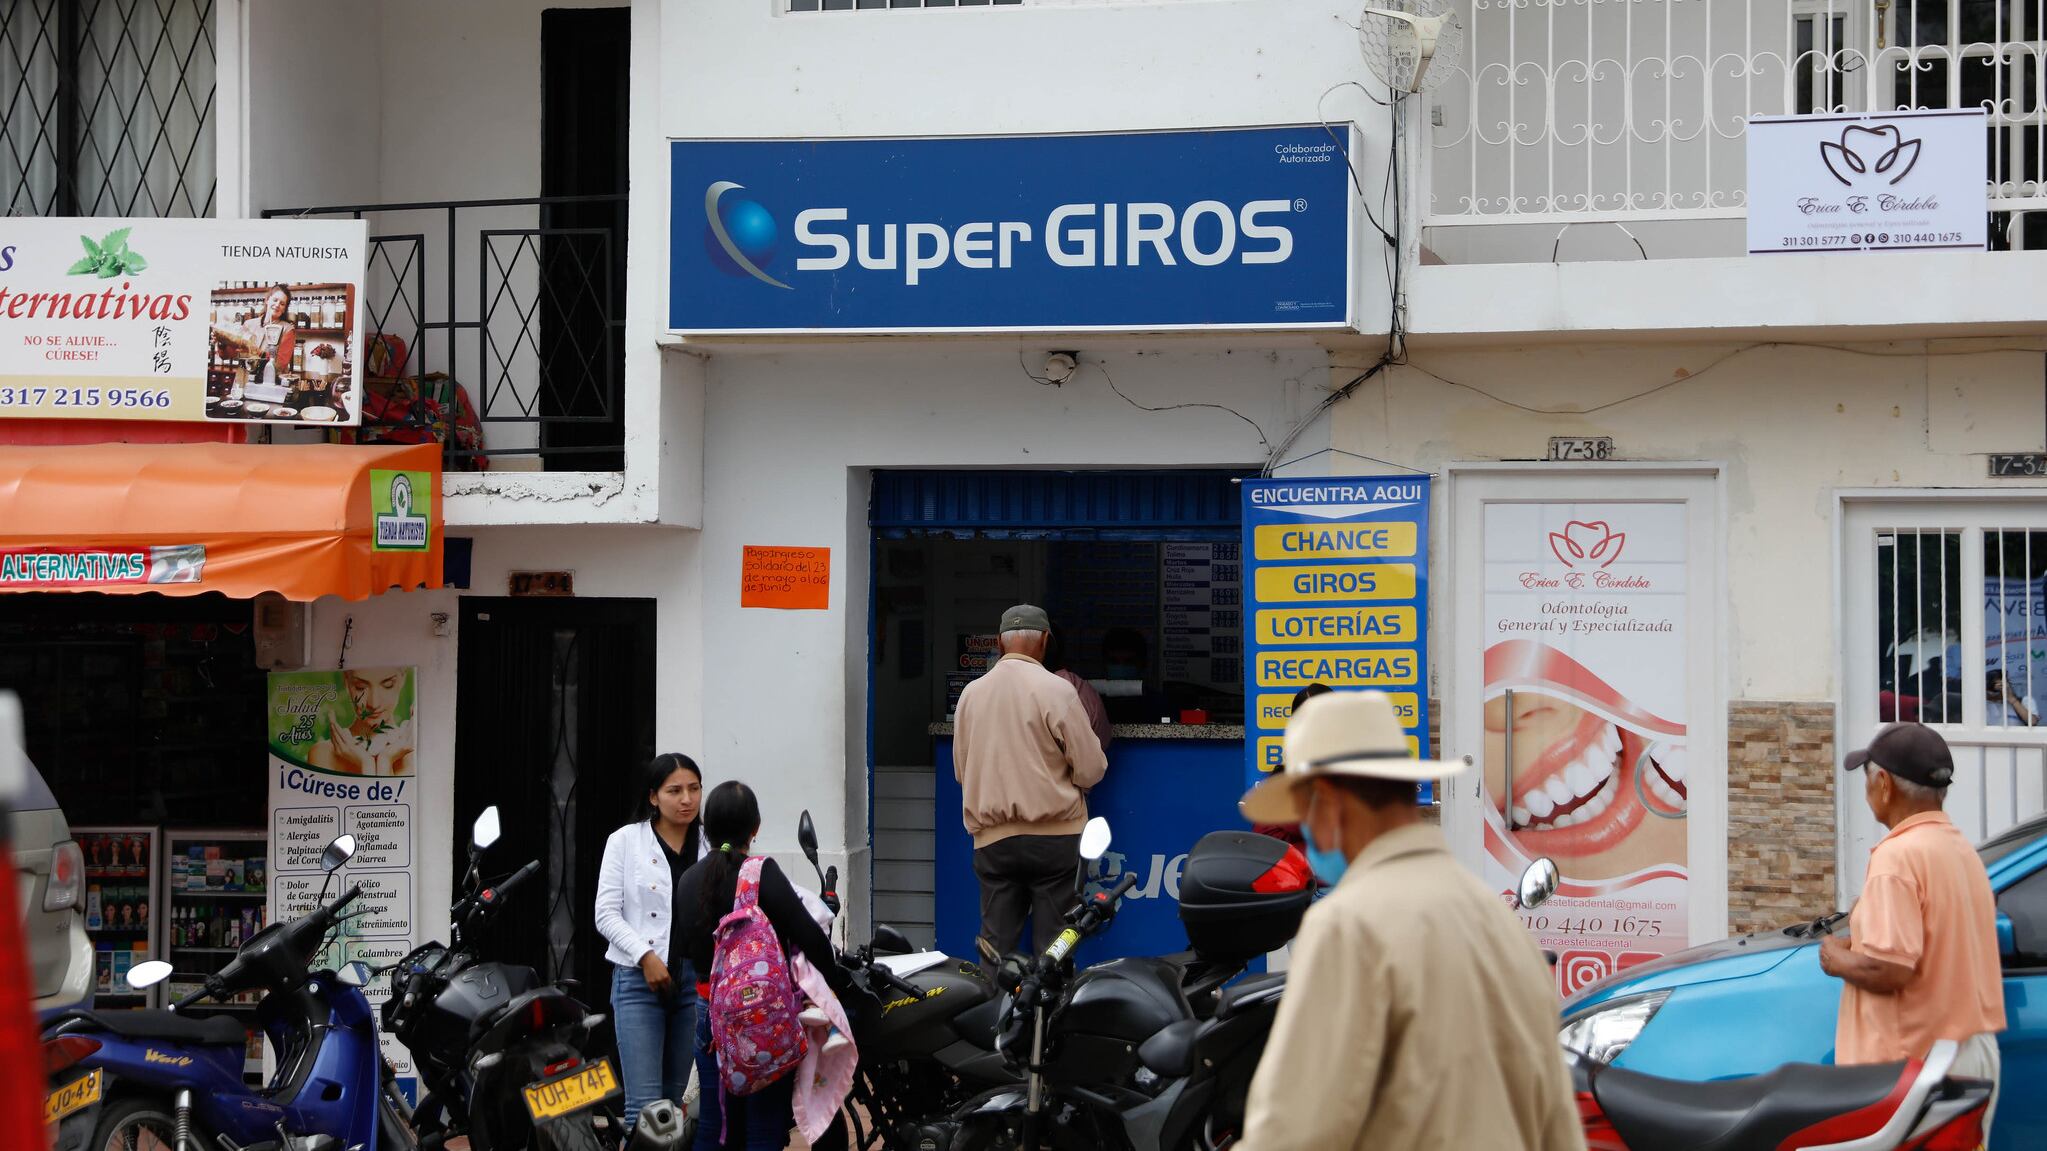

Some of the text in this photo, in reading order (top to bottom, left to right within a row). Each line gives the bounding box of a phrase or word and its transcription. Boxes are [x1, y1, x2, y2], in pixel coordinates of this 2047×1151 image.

[1275, 142, 1336, 154] Colaborador
[1280, 153, 1331, 163] Autorizado
[1797, 193, 1939, 215] Erica E. Córdoba
[1782, 232, 1962, 246] 311 301 5777 310 440 1675
[794, 207, 1032, 285] Super
[222, 245, 348, 260] TIENDA NATURISTA
[24, 336, 117, 347] NO SE ALIVIE...
[45, 348, 98, 360] CÚRESE!
[1, 389, 170, 407] 317 215 9566
[1552, 440, 1607, 460] 17-38
[1251, 485, 1421, 503] ENCUENTRA AQUI
[1282, 529, 1388, 551] CHANCE
[1, 553, 144, 581] ALTERNATIVAS
[1293, 572, 1376, 594] GIROS
[1518, 571, 1650, 589] Erica E. Córdoba
[1272, 611, 1401, 637] LOTERÍAS
[1498, 618, 1672, 635] General y Especializada
[1263, 657, 1411, 680] RECARGAS
[277, 692, 336, 714] Salud
[300, 715, 316, 728] 25
[279, 726, 313, 745] Años
[280, 765, 405, 802] ¡Cúrese de!
[286, 814, 334, 826] Amigdalitis
[356, 810, 397, 819] Cansancio,
[356, 820, 405, 830] Agotamiento
[287, 832, 320, 842] Alergias
[357, 833, 380, 842] Vejiga
[287, 847, 327, 856] Palpitació
[356, 843, 397, 852] Inflamada
[287, 856, 320, 865] del Cora
[357, 855, 387, 864] Diarrea
[287, 881, 310, 889] Dolor
[356, 880, 381, 888] Cólico
[287, 892, 336, 901] de Garganta
[356, 890, 397, 899] Menstrual
[287, 903, 316, 912] Artritis
[356, 918, 408, 929] Estreñimiento
[1520, 916, 1663, 937] 10 440 1675
[357, 949, 403, 958] Calambres
